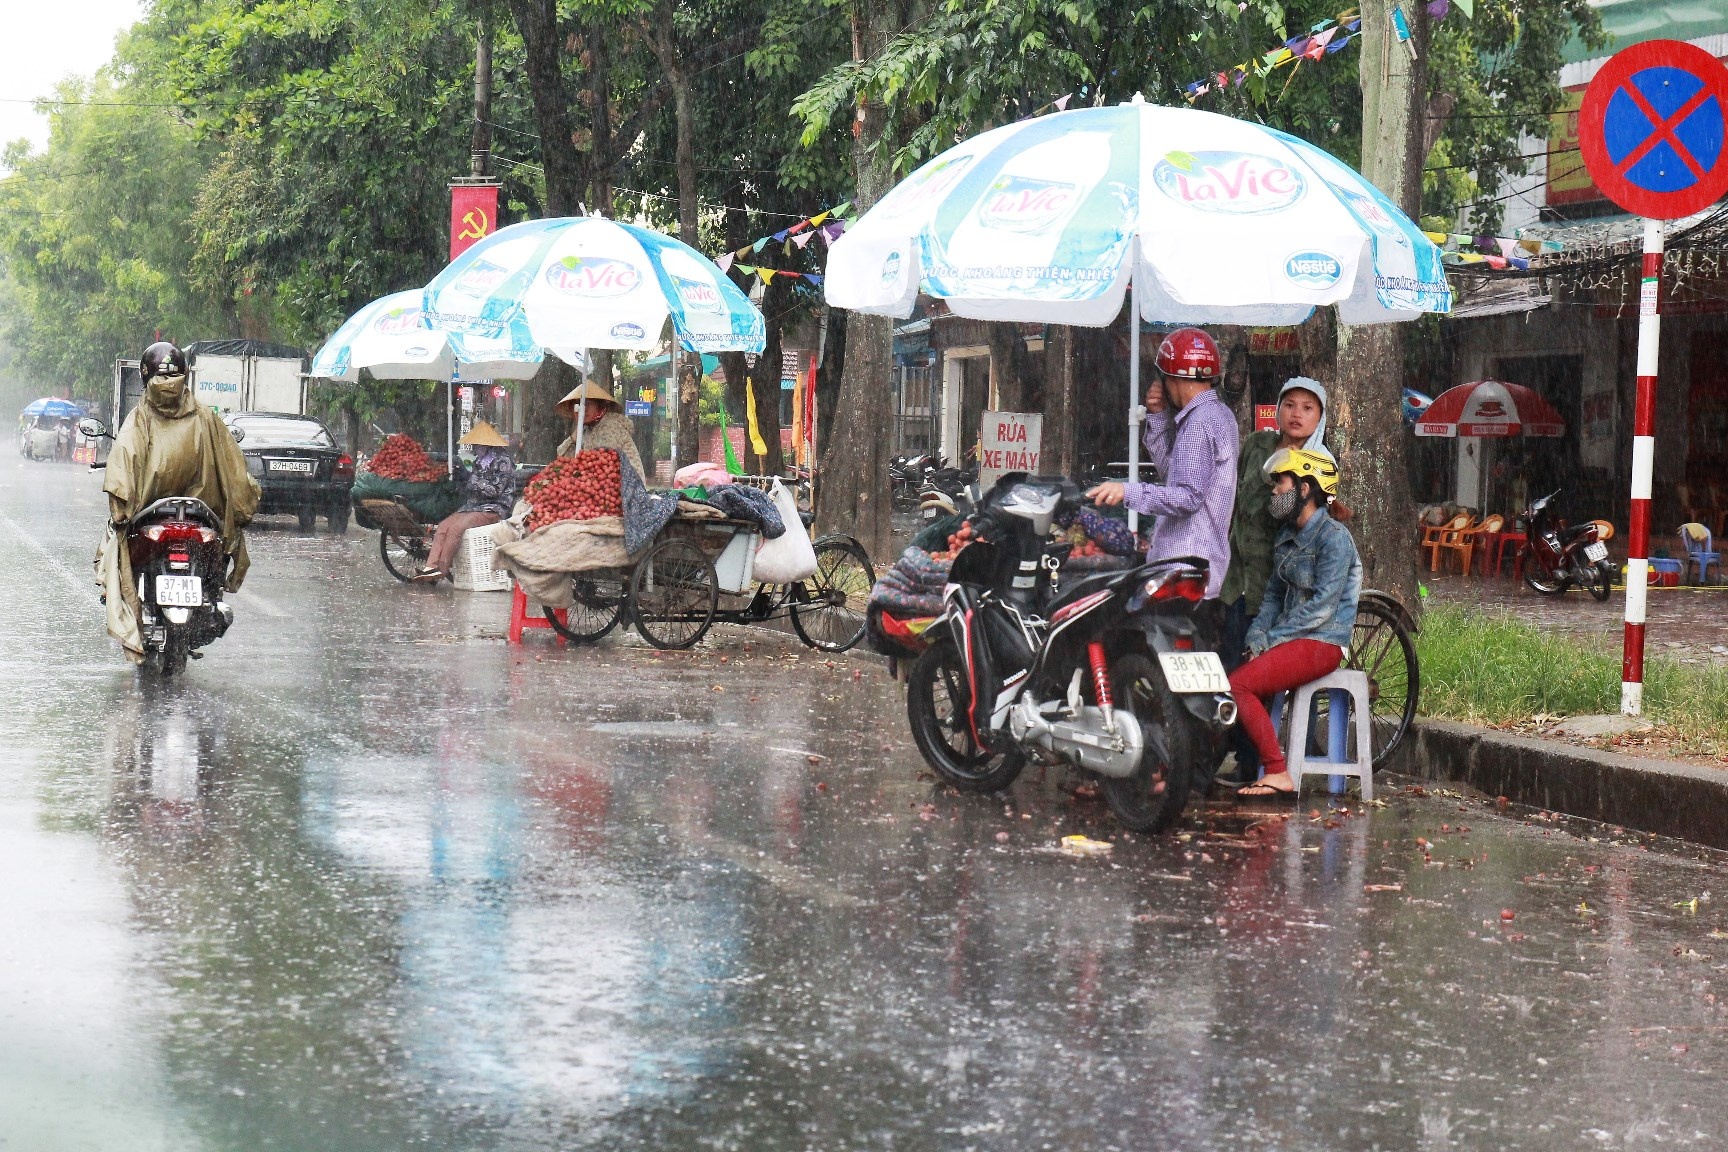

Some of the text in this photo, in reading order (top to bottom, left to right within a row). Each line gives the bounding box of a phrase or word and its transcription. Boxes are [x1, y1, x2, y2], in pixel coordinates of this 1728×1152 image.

[963, 264, 1023, 279] KHOÁNG
[1026, 265, 1070, 280] THIÊN
[1075, 267, 1117, 281] NHIÊN
[997, 415, 1027, 443] RỬA
[982, 446, 1038, 471] XE MÁY
